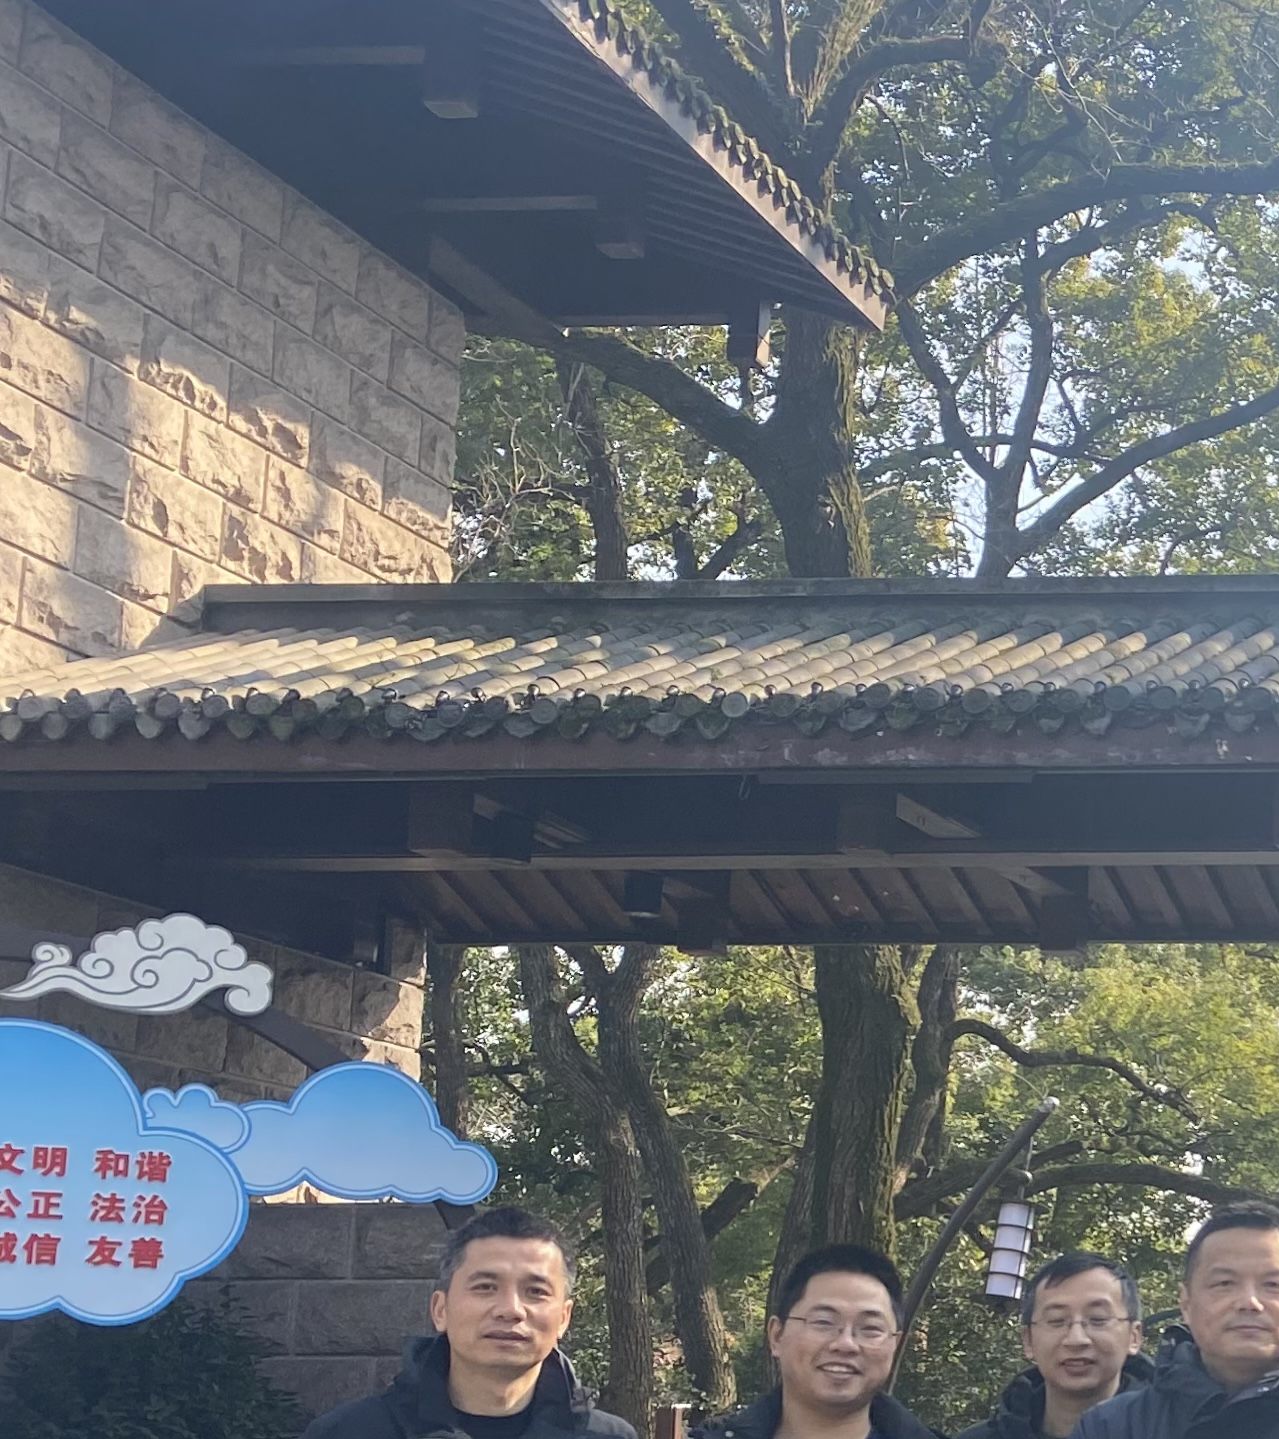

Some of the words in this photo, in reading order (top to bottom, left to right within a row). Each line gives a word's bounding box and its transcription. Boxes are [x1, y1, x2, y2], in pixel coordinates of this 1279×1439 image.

[0, 1143, 68, 1178] 文明
[94, 1149, 172, 1183] 和谐
[90, 1192, 168, 1226] 法治
[85, 1236, 164, 1269] 友善
